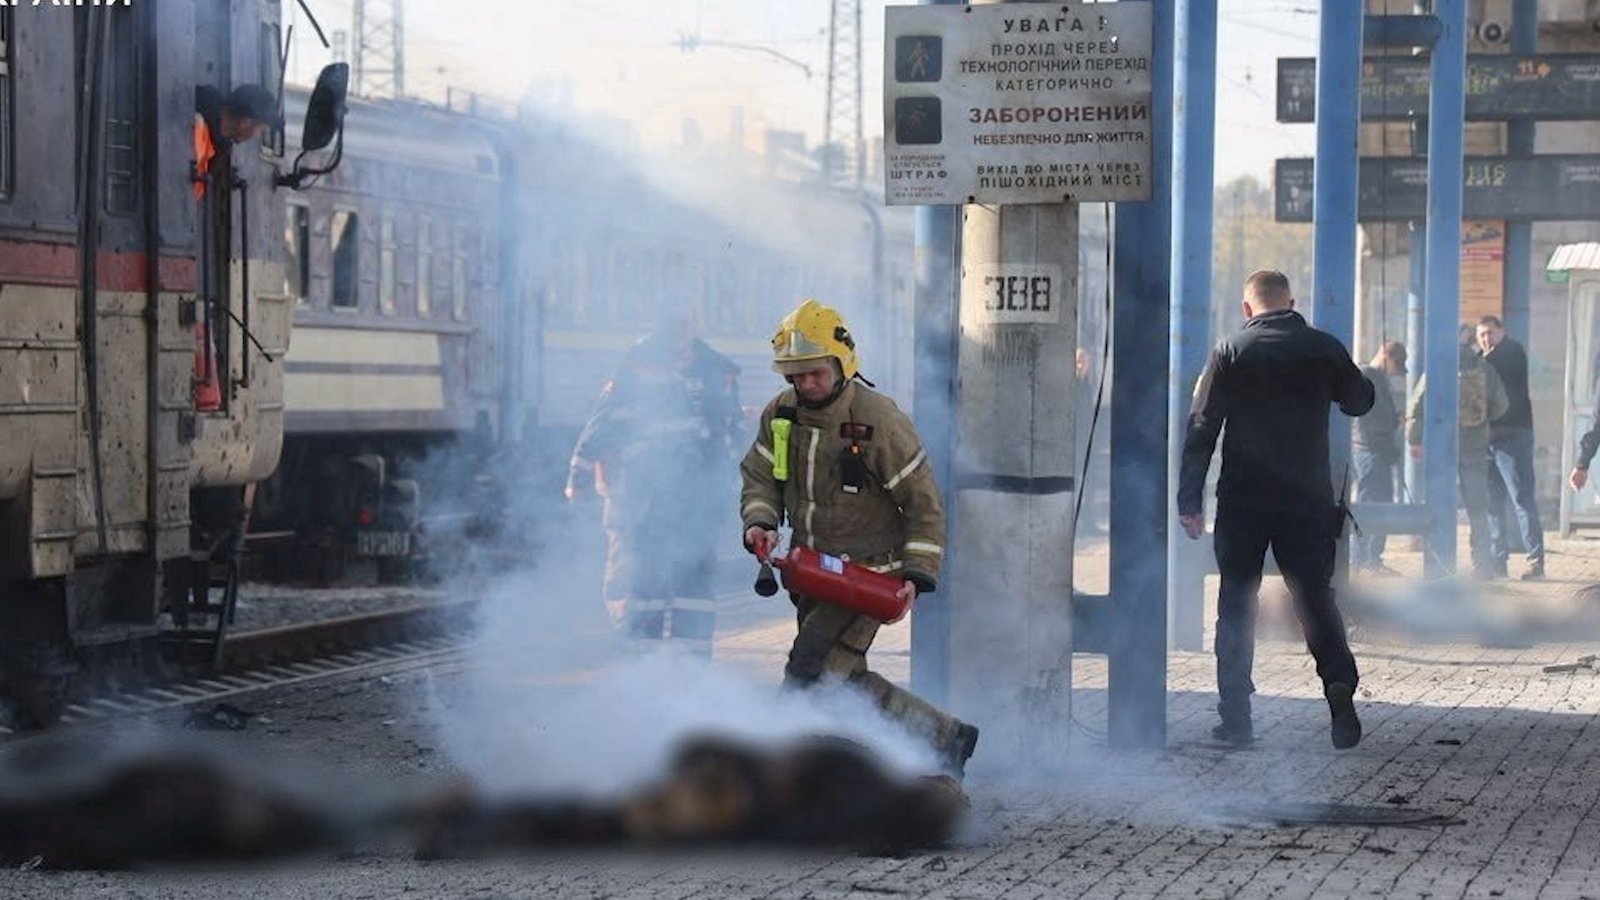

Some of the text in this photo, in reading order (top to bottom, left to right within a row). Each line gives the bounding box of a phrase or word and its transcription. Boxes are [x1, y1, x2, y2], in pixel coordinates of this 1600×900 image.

[1003, 18, 1084, 33] УВАГА
[991, 41, 1120, 57] ПРОХІД ЧЕРЕЗ
[960, 57, 1148, 73] ТЕХНОЛОГІЧНИЙ ПЕРЕХІД
[996, 77, 1113, 91] КАТЕГОРИЧНО
[969, 101, 1148, 123] ЗАБОРОНЕНИЙ
[973, 131, 1145, 146] НЕБЕЗПЕЧНО ДЛЯ ЖИТТЯ
[890, 170, 948, 180] ШТРАФ
[977, 162, 1142, 175] ВИХІД ДО МІСТА ЧЕРЕЗ
[980, 174, 1143, 188] ПІШОХІДНИЙ МІСТ
[985, 276, 1051, 312] 388
